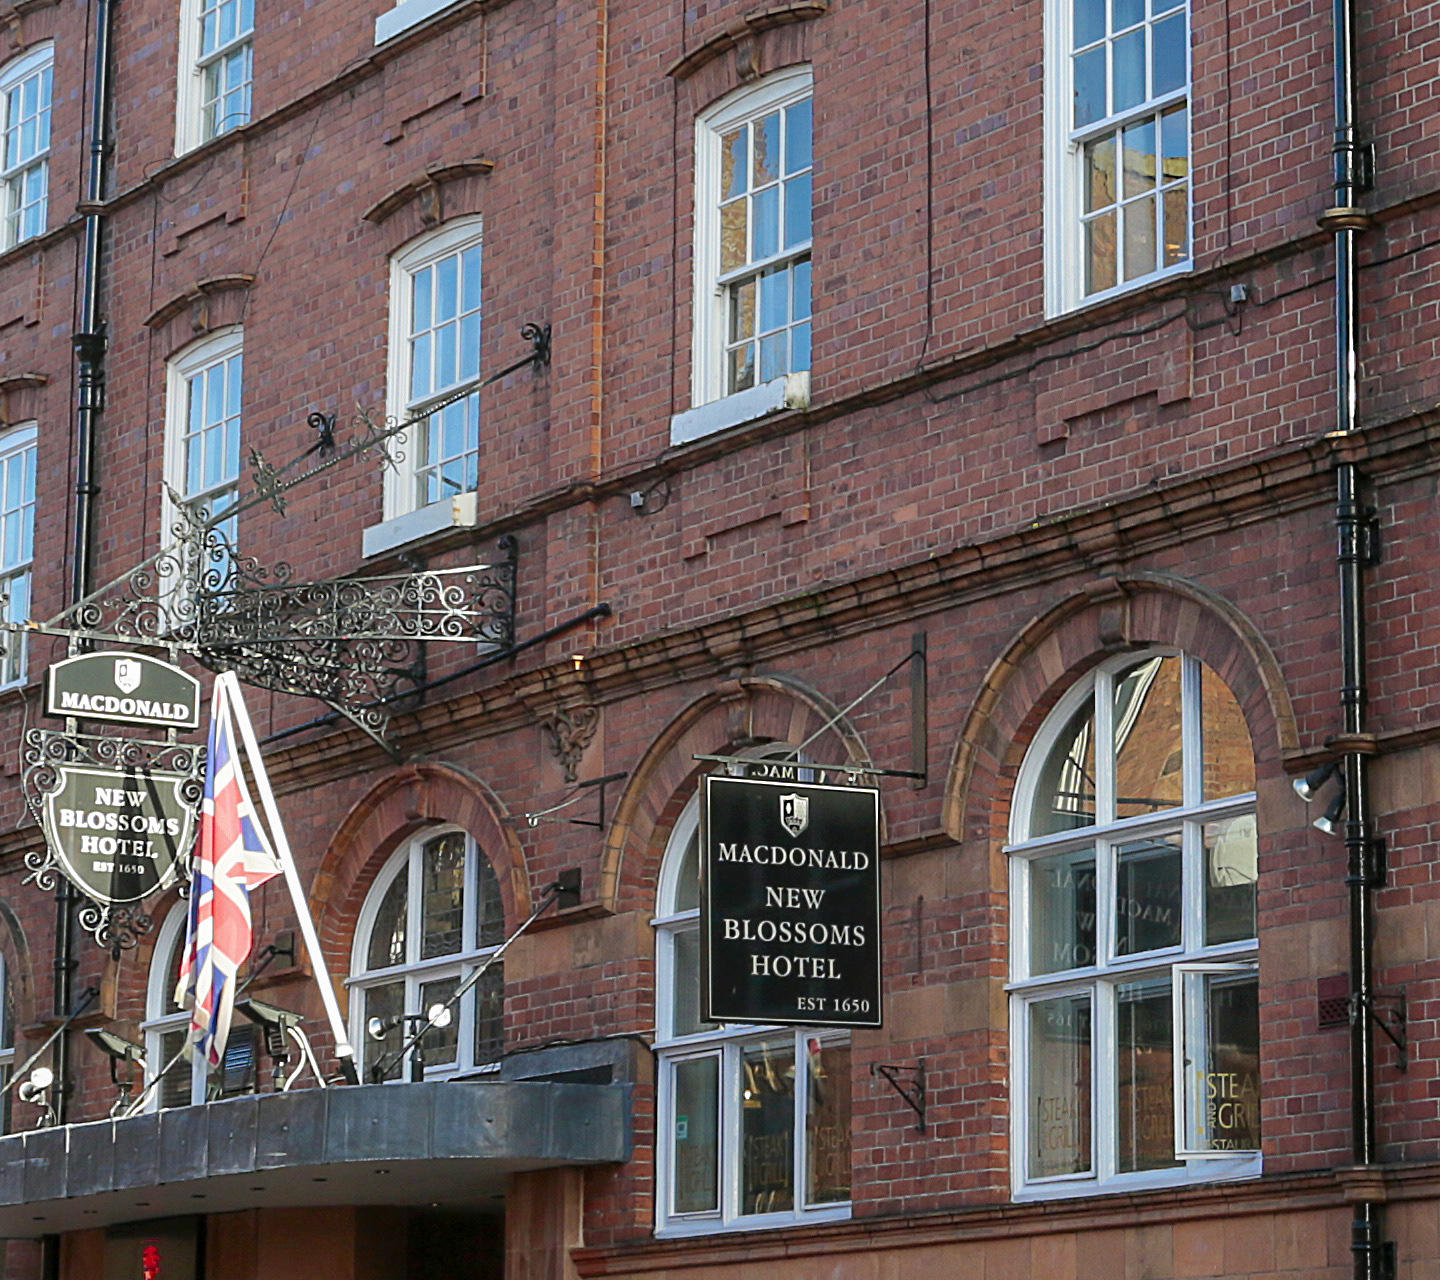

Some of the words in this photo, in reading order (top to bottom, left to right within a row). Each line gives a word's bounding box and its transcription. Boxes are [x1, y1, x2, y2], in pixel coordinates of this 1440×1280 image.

[61, 692, 189, 720] MACDONALD
[95, 787, 147, 807] NEW
[60, 809, 179, 835] BLOSSOMS
[81, 835, 158, 858] HOTEL
[718, 842, 869, 870] MACDONALD
[93, 862, 114, 872] EST
[765, 886, 826, 910] NEW
[723, 918, 866, 946] BLOSSOMS
[750, 954, 841, 980] HOTEL
[797, 997, 826, 1011] EST
[833, 997, 870, 1013] 1650
[1207, 1072, 1255, 1098] STEA
